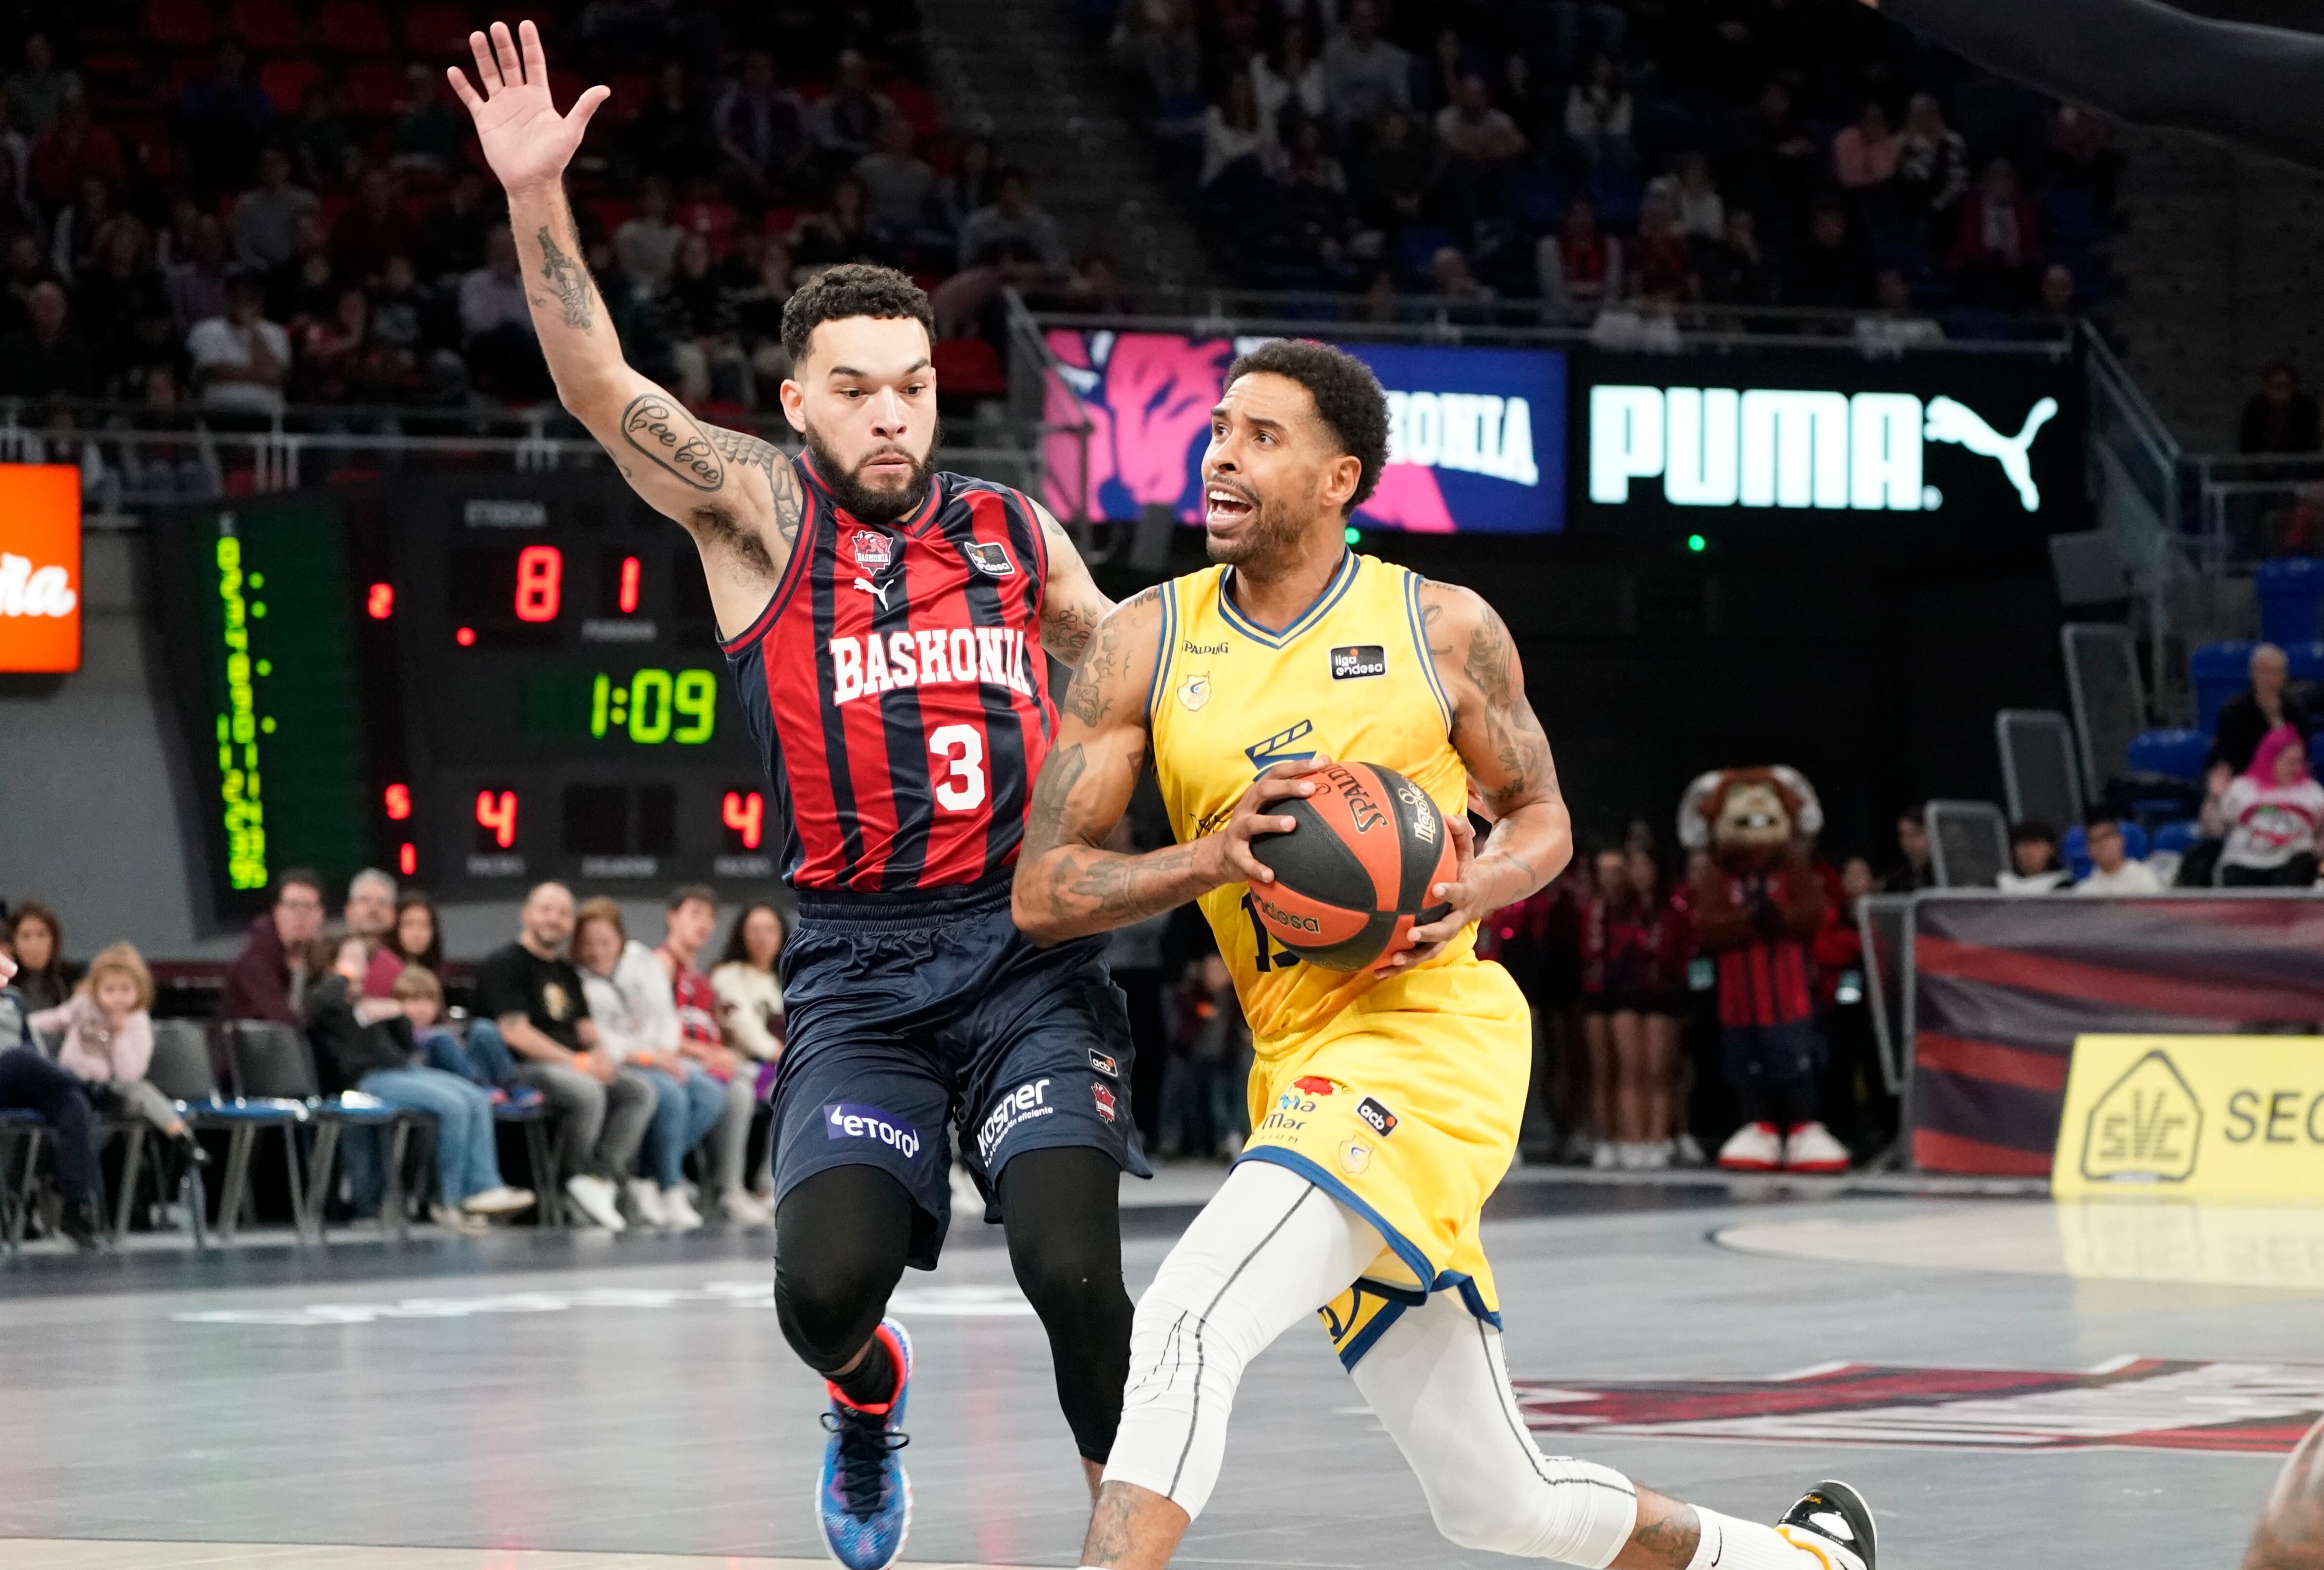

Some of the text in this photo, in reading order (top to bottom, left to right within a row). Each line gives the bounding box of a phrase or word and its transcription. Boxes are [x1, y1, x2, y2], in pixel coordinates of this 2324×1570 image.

[515, 546, 562, 622] 8
[619, 556, 640, 613] 1
[830, 627, 1033, 704] BASKONIA
[1336, 663, 1383, 676] endesa
[591, 668, 717, 744] 1:09
[929, 724, 986, 811] 3
[476, 791, 517, 848] 4
[722, 792, 763, 849] 4
[1360, 1104, 1385, 1131] acb
